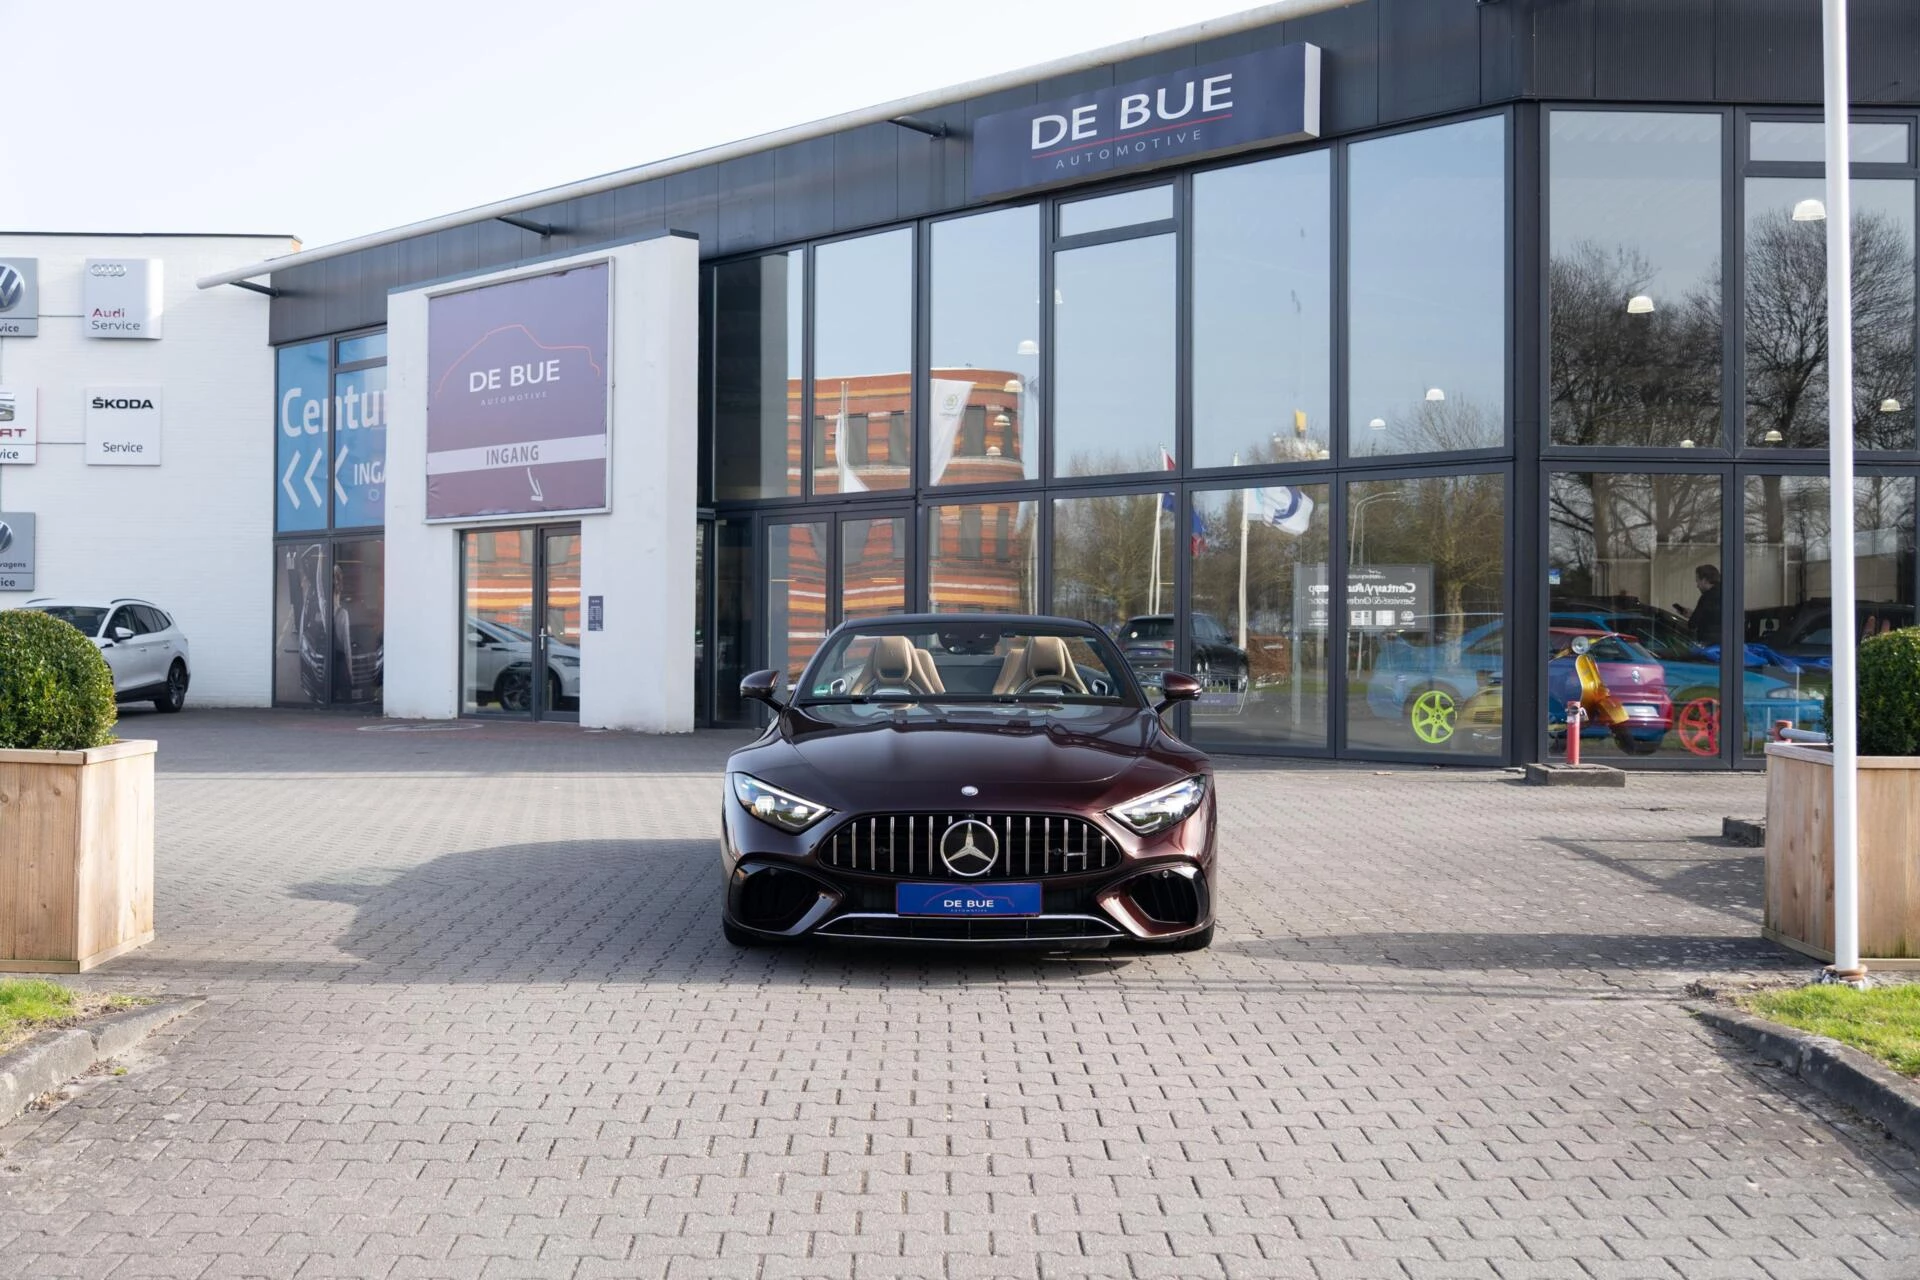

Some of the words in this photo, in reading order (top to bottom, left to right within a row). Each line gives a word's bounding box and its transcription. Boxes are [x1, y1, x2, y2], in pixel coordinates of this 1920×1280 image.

[1031, 104, 1098, 150] DE
[1120, 73, 1233, 130] BUE
[1055, 129, 1202, 169] AUTOMOTIVE
[92, 307, 125, 318] Audi
[91, 320, 141, 331] Service
[469, 368, 501, 393] DE
[510, 359, 560, 387] BUE
[92, 397, 154, 409] ŠKODA
[481, 391, 547, 406] AUTOMOTIVE
[102, 442, 143, 453] Service
[486, 445, 540, 466] INGANG
[943, 899, 962, 908] DE
[967, 899, 994, 908] BUE
